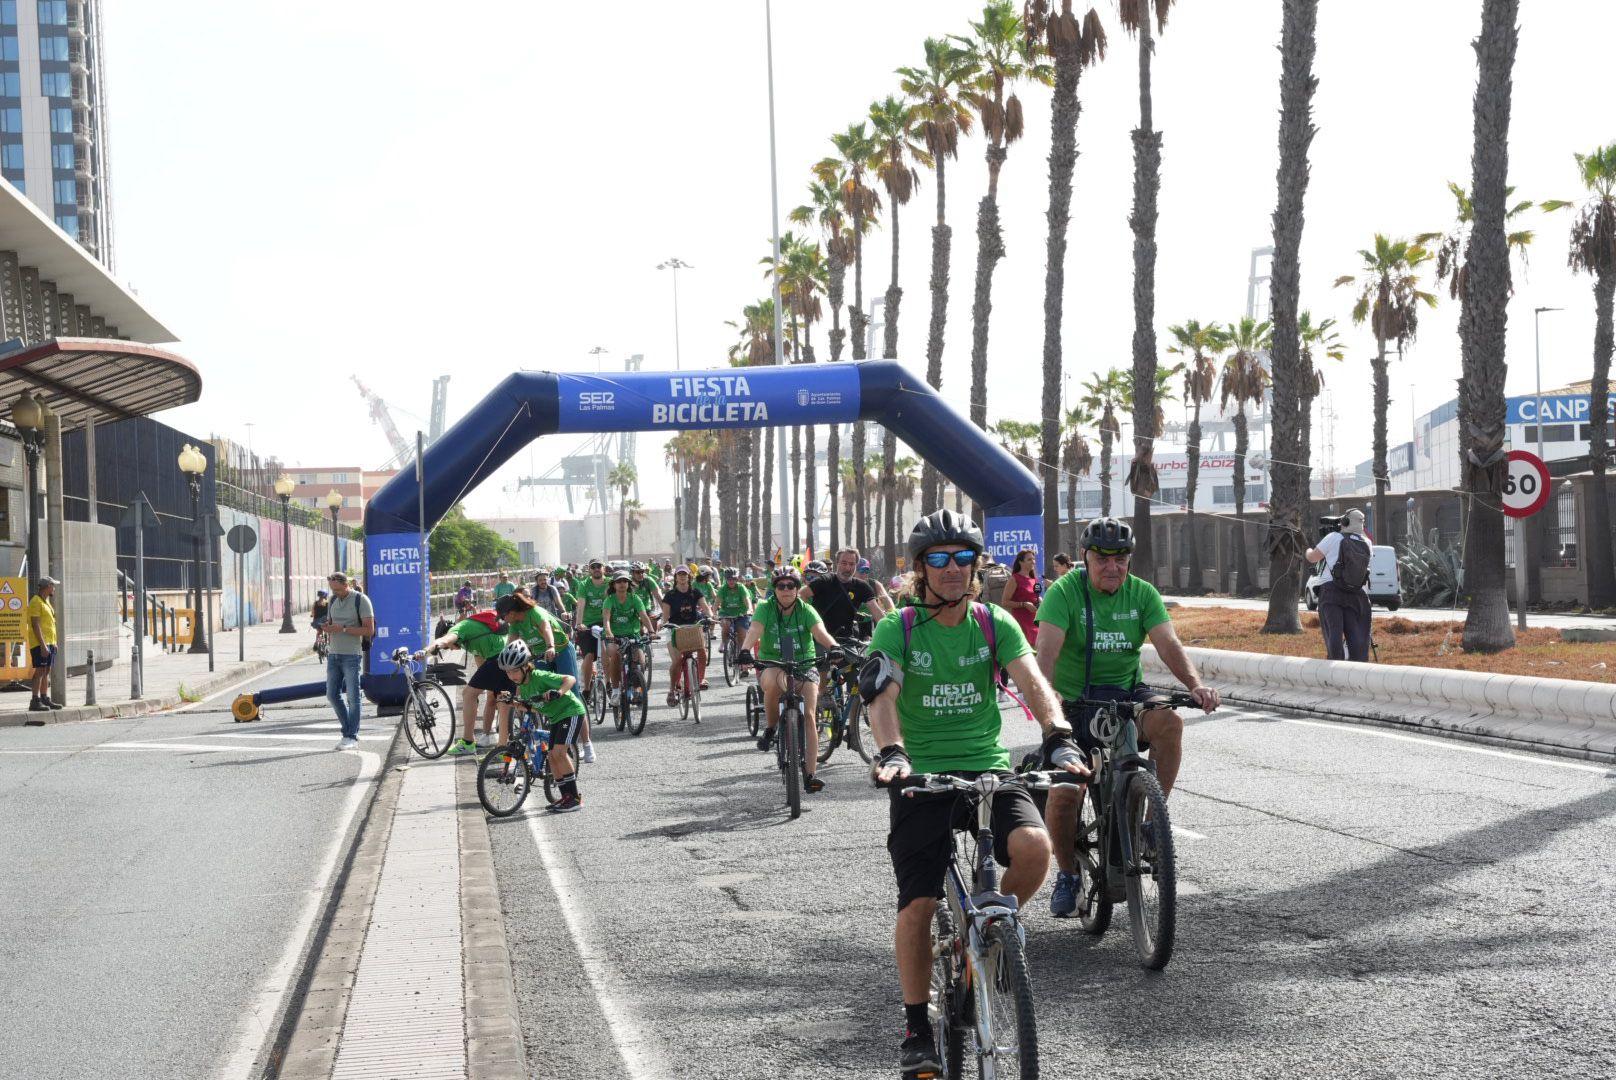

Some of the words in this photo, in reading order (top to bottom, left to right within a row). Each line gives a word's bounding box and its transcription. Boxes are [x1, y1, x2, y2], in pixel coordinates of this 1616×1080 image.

[670, 377, 751, 397] FIESTA
[652, 402, 768, 423] BICICLETA
[1503, 474, 1537, 495] 60
[993, 530, 1032, 542] FIESTA
[380, 548, 420, 560] FIESTA
[372, 561, 422, 576] BICICLET
[1096, 632, 1126, 640] FIESTA
[912, 650, 932, 668] 30
[932, 683, 974, 696] FIESTA
[922, 693, 982, 707] BICICLETA
